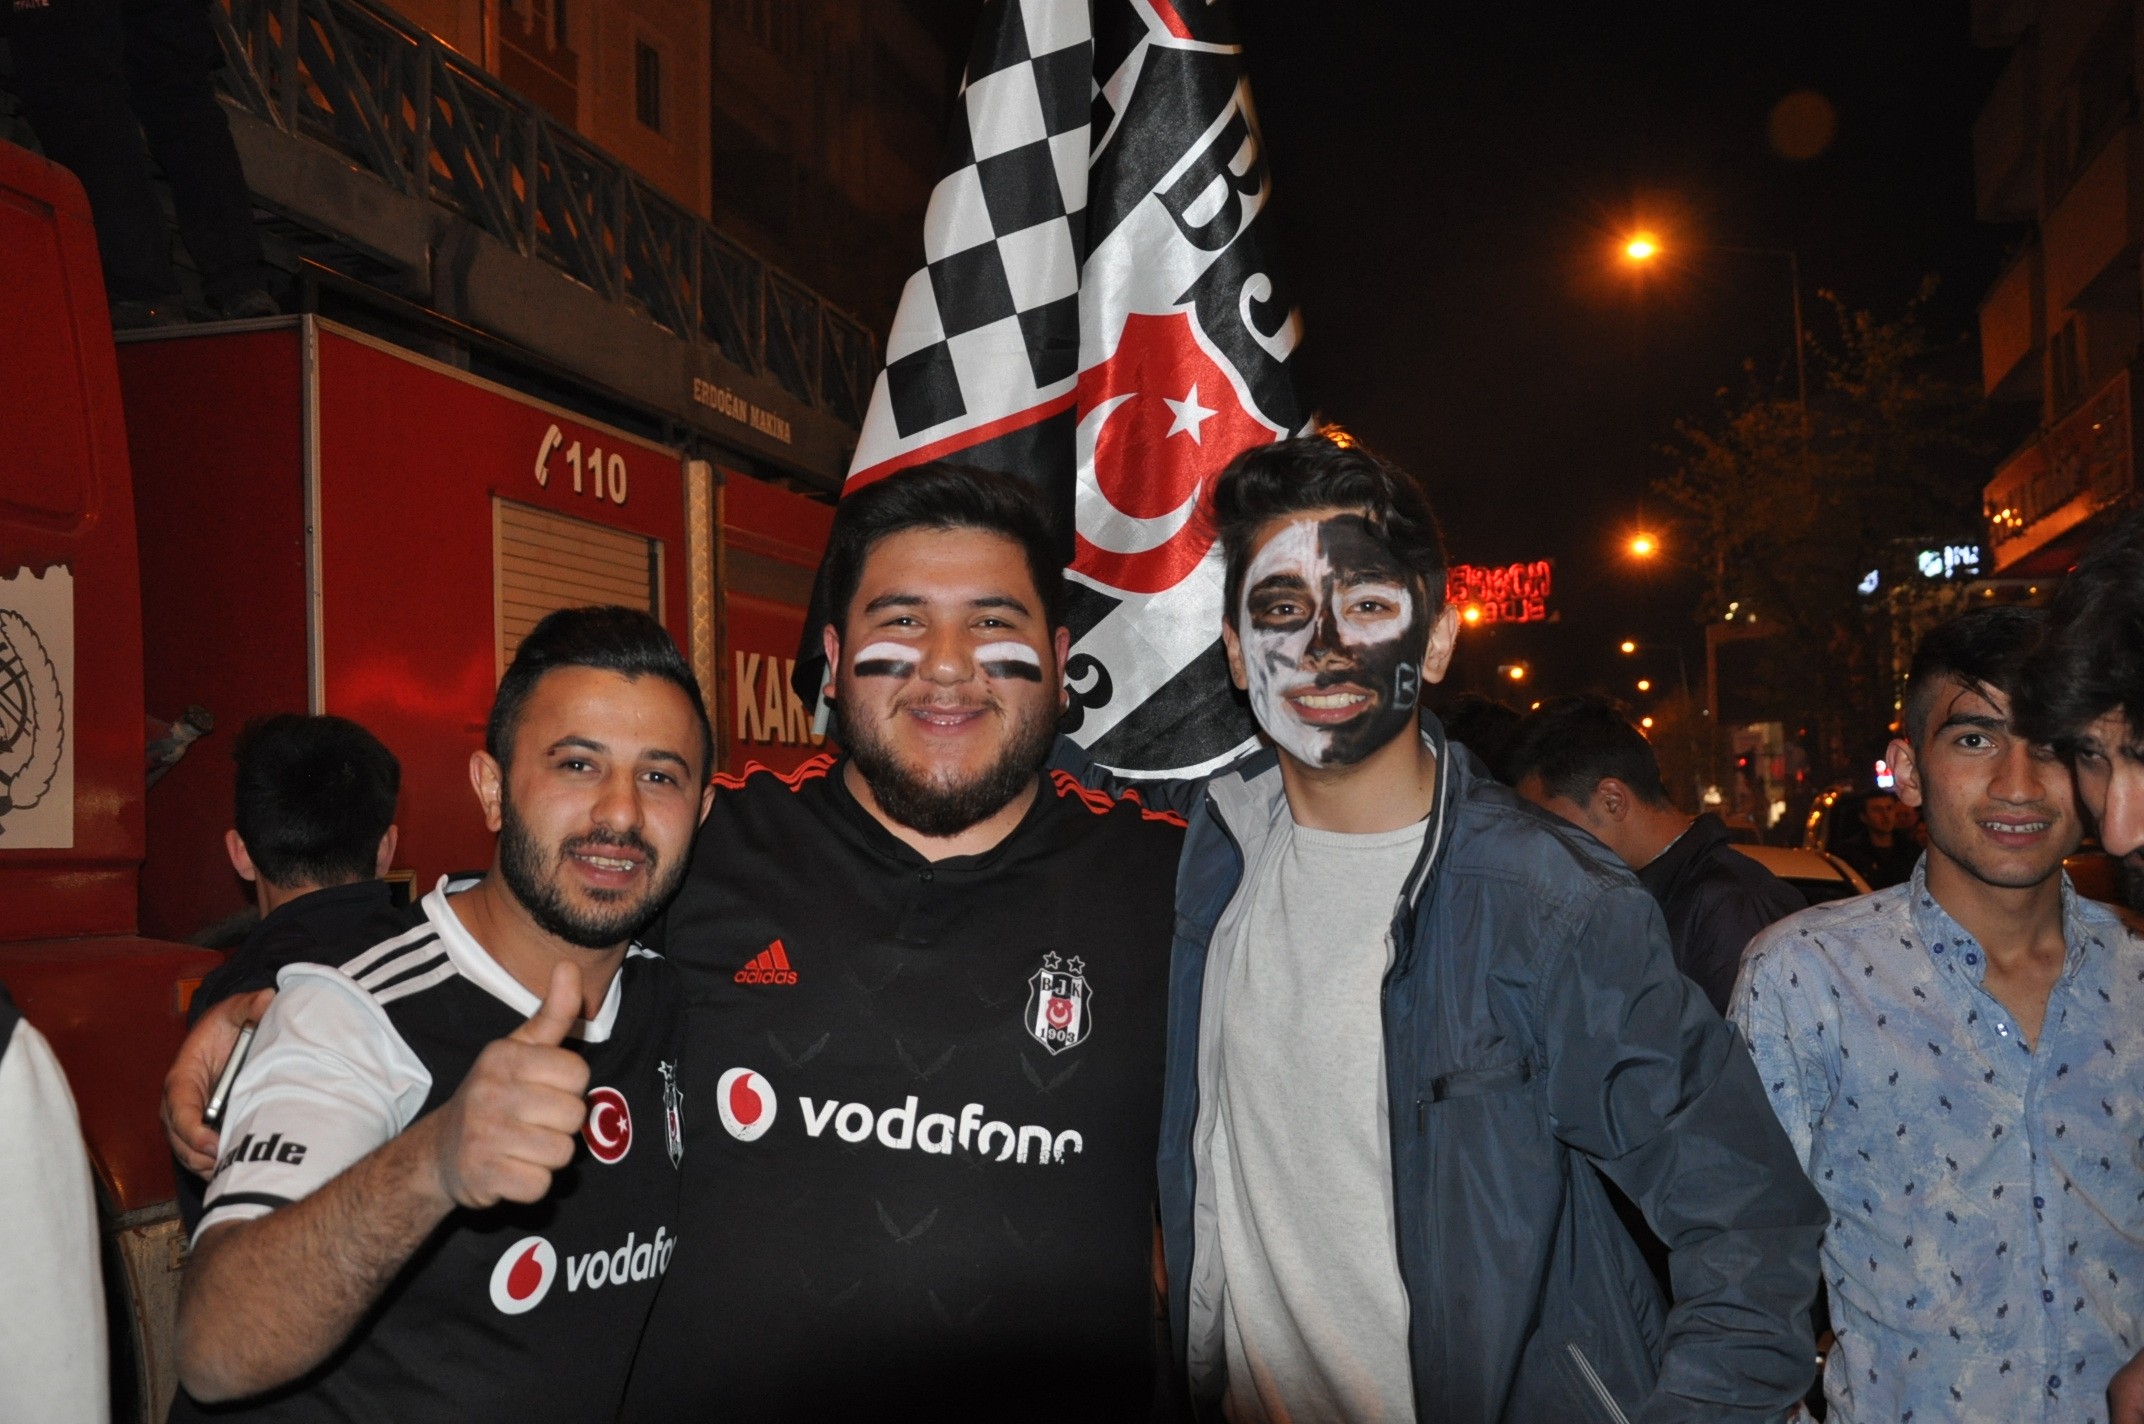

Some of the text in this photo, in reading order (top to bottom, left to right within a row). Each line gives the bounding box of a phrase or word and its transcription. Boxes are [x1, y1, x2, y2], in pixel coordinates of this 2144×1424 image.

[693, 377, 748, 423] ERDOĞAN
[566, 440, 627, 504] 110
[734, 968, 798, 985] adidas
[1041, 977, 1081, 998] BJK
[1040, 1027, 1076, 1043] 1903
[566, 1225, 678, 1293] vodafo
